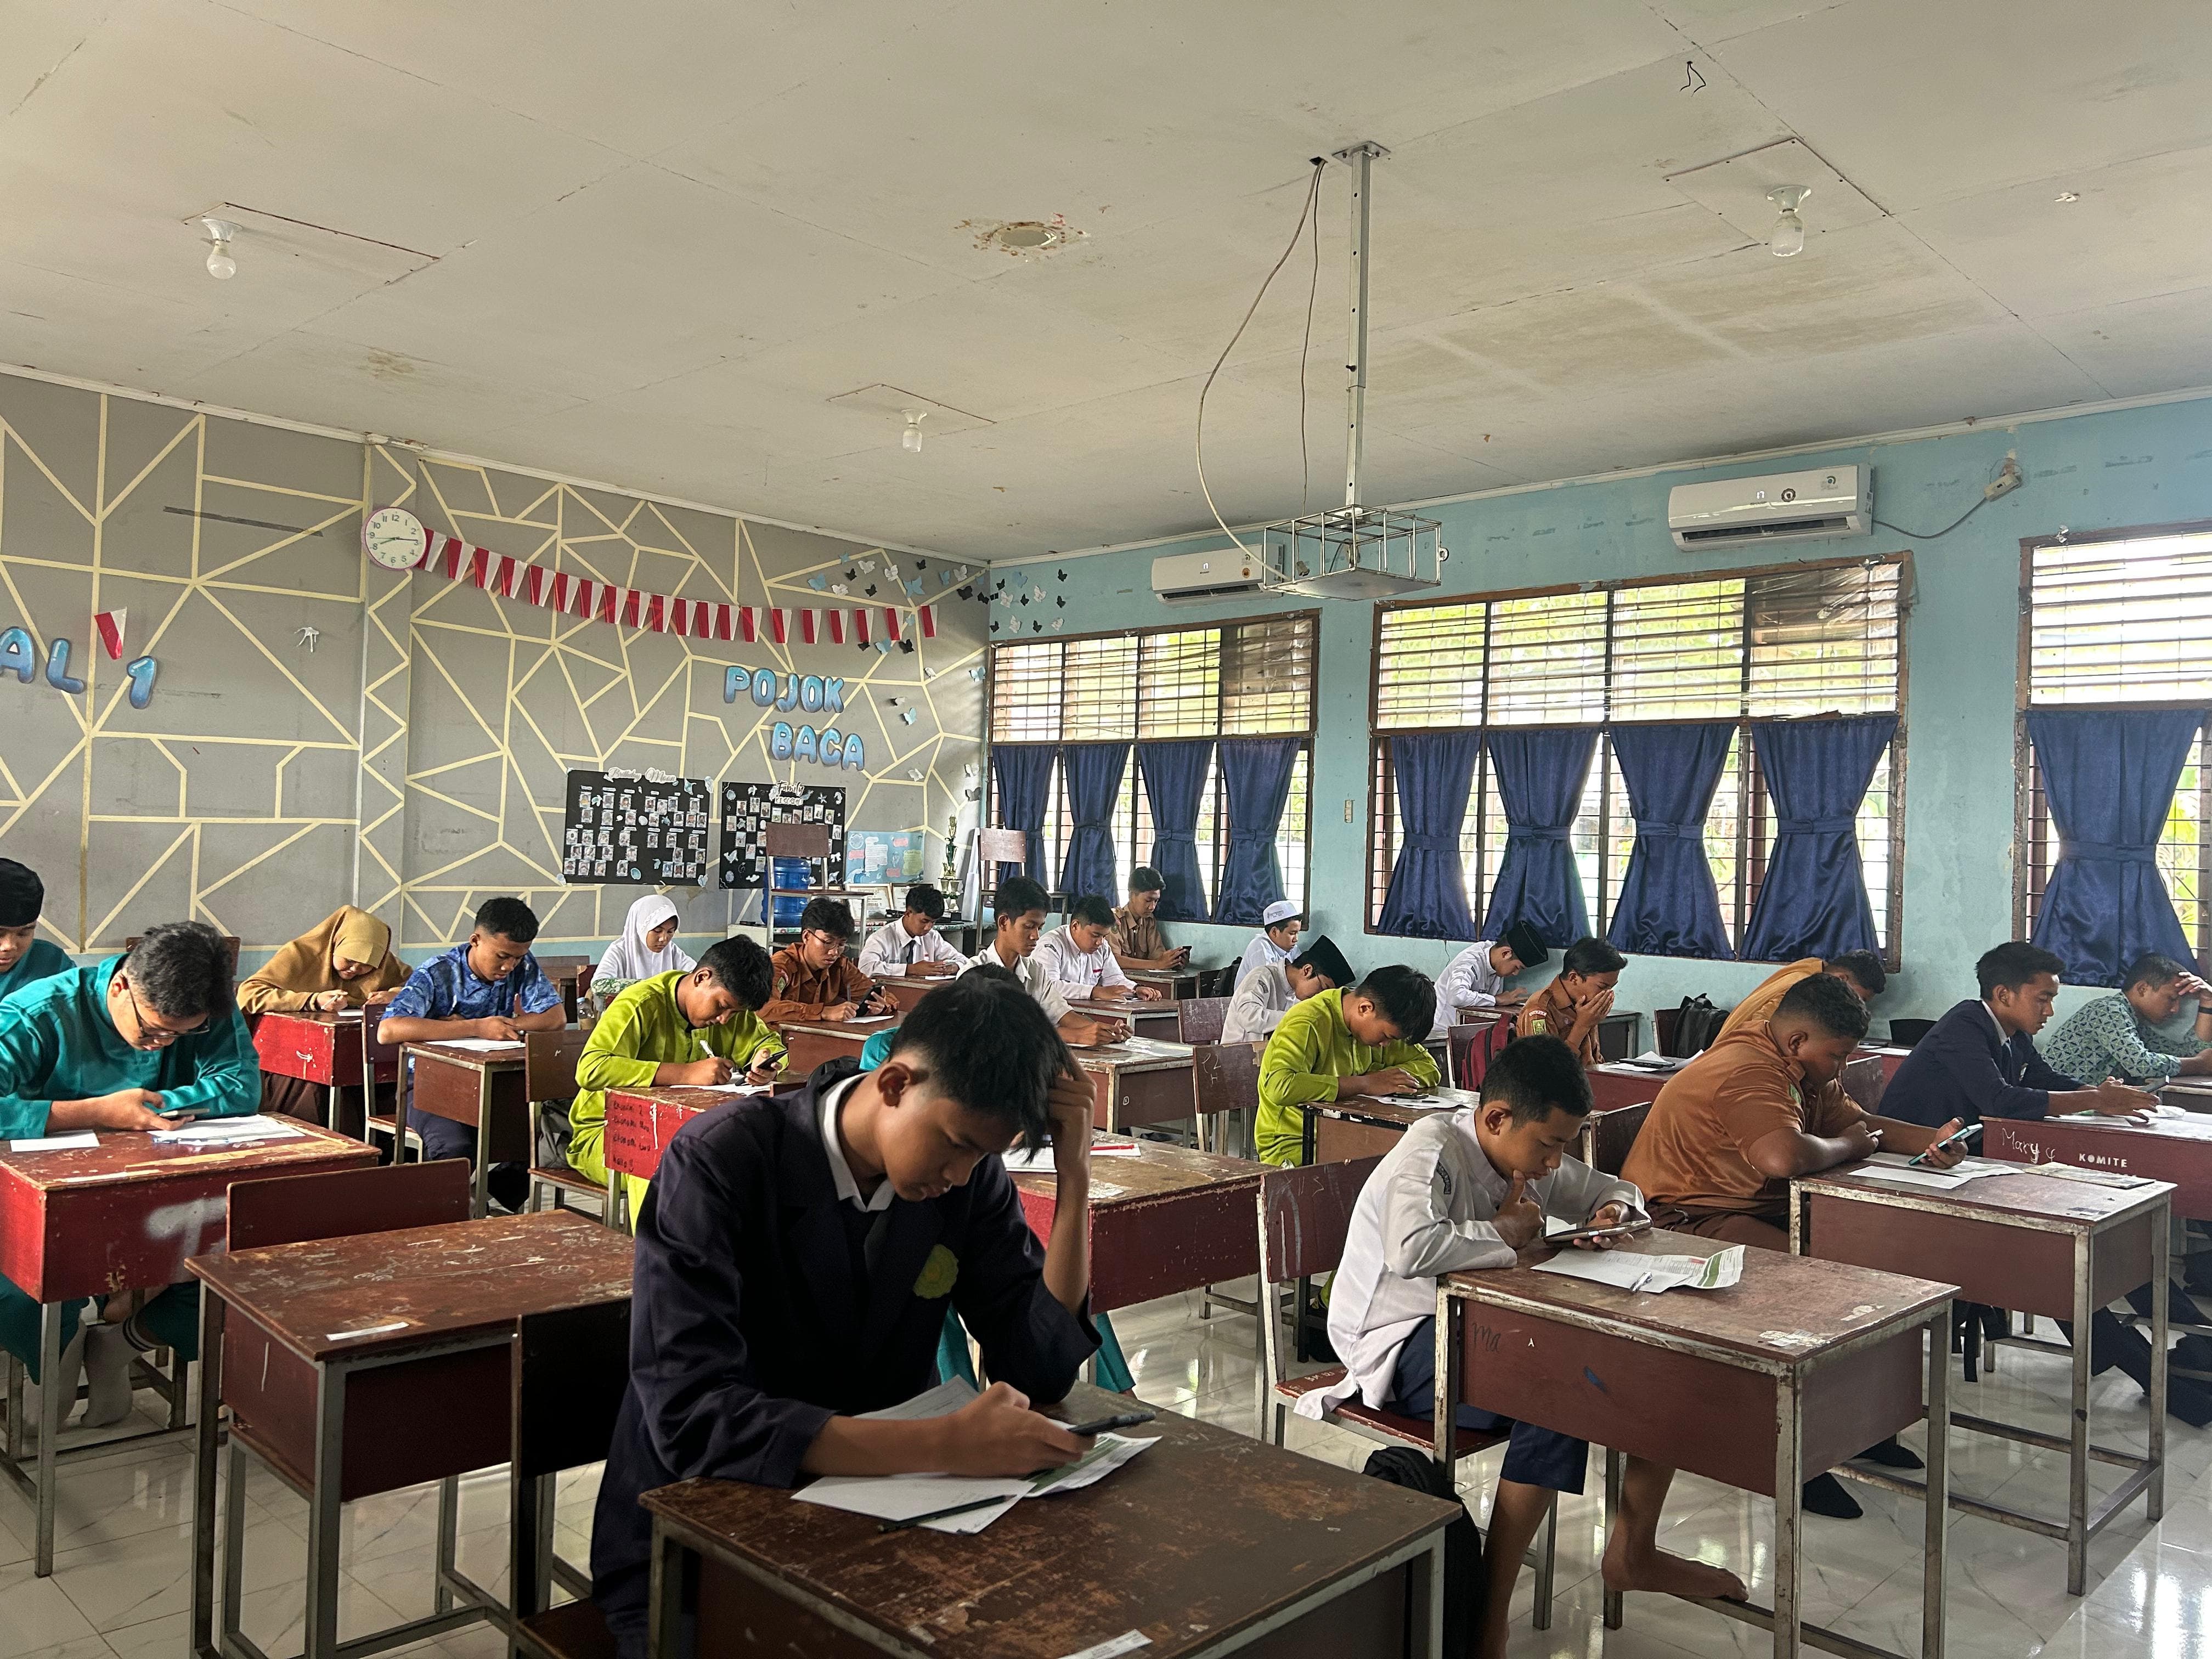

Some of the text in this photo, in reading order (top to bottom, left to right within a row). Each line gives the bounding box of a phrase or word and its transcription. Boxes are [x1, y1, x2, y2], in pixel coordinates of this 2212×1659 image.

[127, 656, 157, 709] 1
[724, 665, 844, 713] POJOK
[771, 721, 865, 771] BACA
[777, 781, 804, 797] Family
[2079, 1153, 2128, 1167] KOMITE
[1528, 1338, 1534, 1347] A
